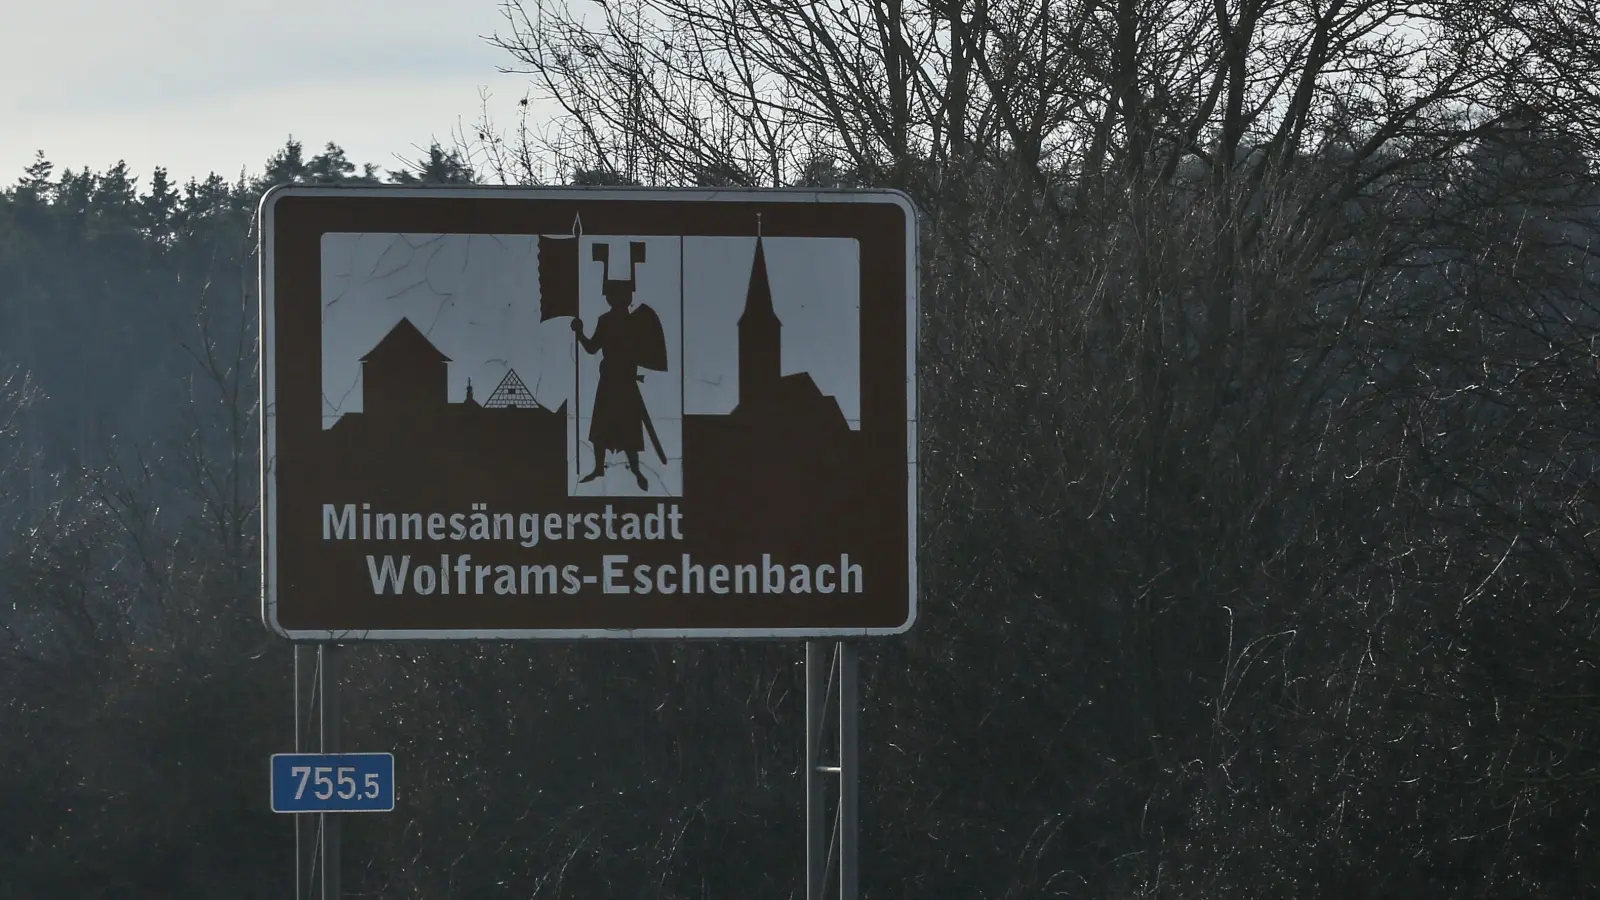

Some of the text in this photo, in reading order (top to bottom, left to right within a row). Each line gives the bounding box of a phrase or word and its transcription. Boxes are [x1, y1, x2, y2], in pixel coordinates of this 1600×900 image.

[322, 503, 683, 548] Minnesängerstadt
[366, 554, 863, 595] Wolframs-Eschenbach
[291, 766, 380, 801] 755,5
